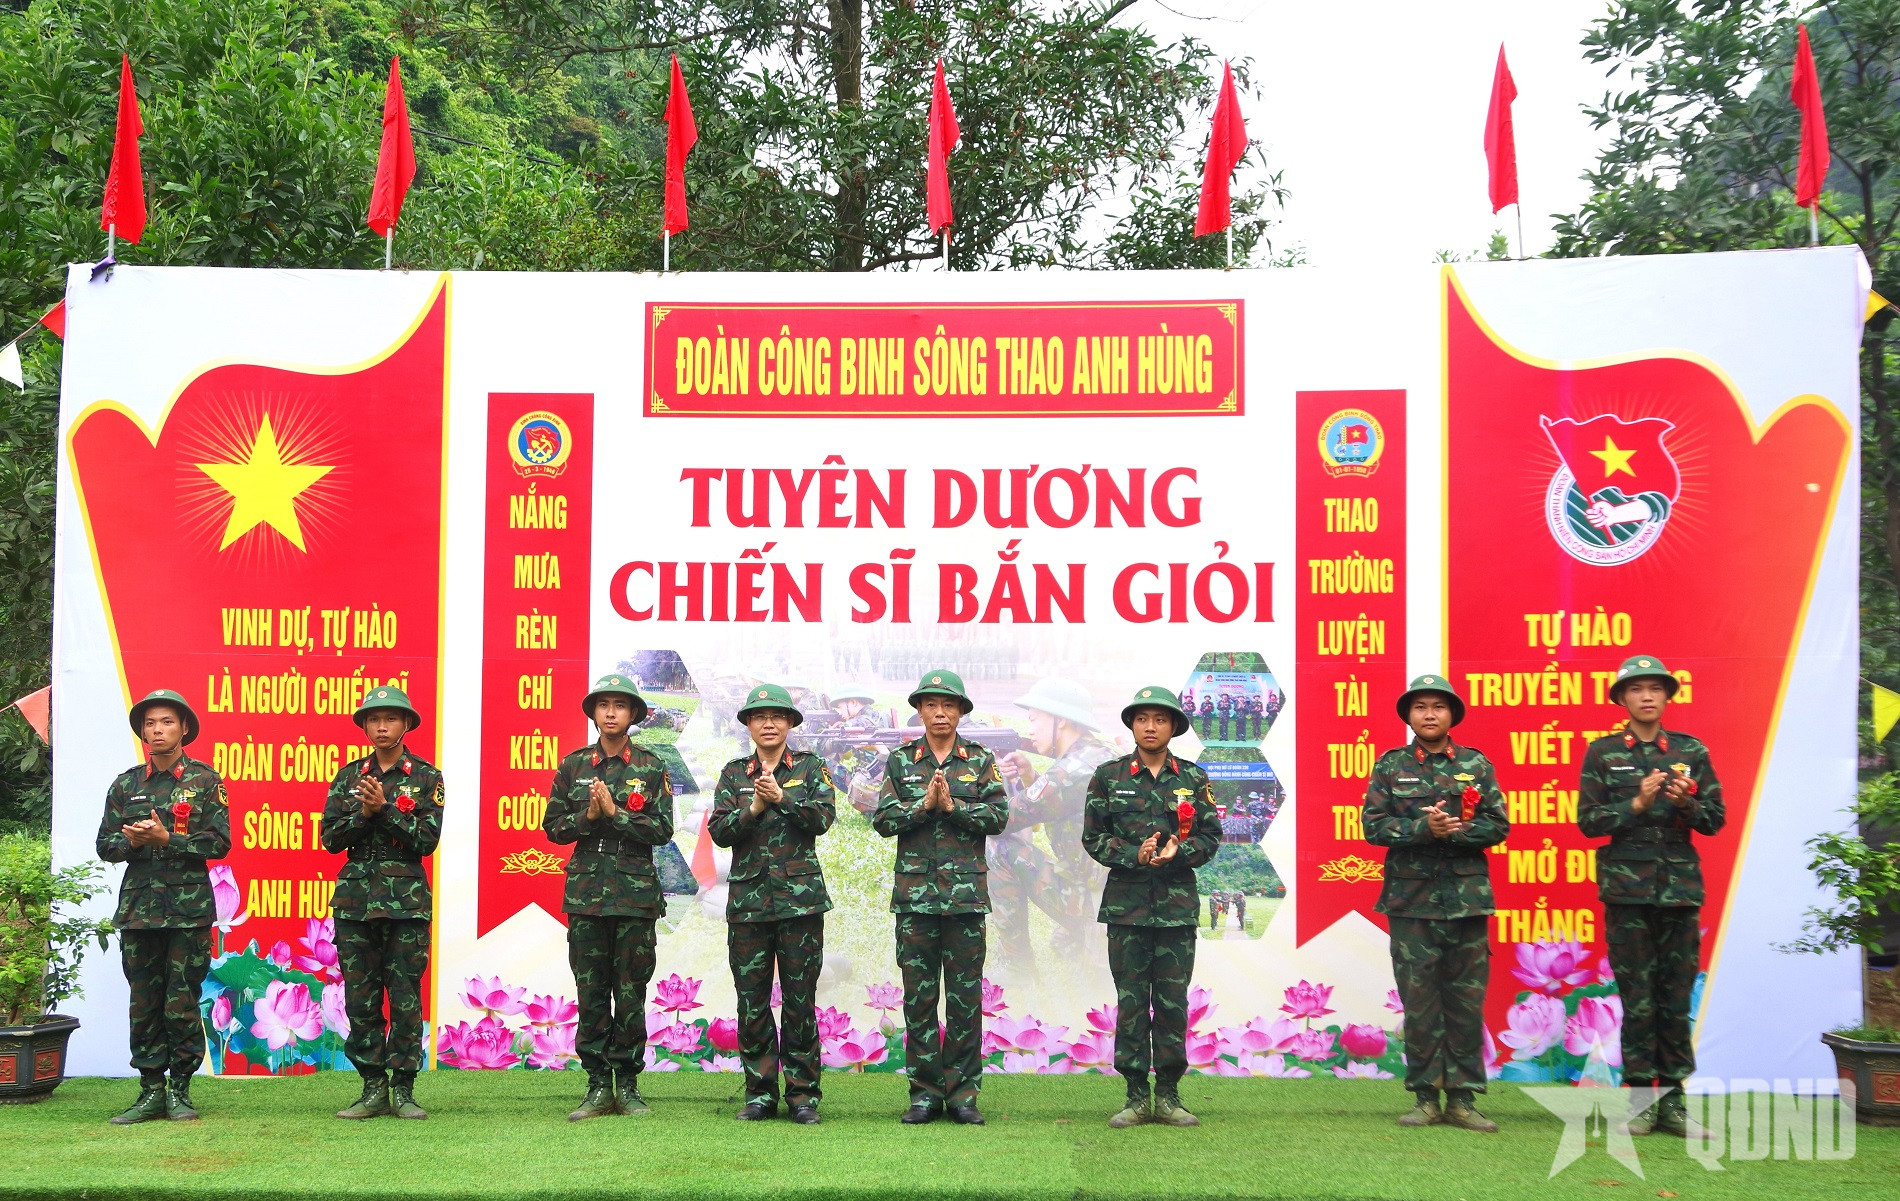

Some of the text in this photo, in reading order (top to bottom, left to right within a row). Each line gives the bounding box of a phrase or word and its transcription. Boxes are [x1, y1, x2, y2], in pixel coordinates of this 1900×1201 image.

[676, 322, 1213, 396] ĐOÀN CÔNG BINH SÔNG THAO ANH HÙNG
[509, 482, 567, 530] NẮNG
[679, 454, 1203, 529] TUYÊN DƯƠNG
[1324, 497, 1379, 534] THAO
[514, 552, 561, 590] MƯA
[609, 539, 1276, 623] CHIẾN SĨ BẮN GIỎI
[1308, 550, 1394, 594] TRƯỜNG
[221, 602, 398, 657] VINH DỰ, TỰ HÀO
[515, 608, 557, 650] RÈN
[1318, 613, 1385, 663] LUYỆN
[1524, 606, 1632, 655] TỰ HÀO
[207, 666, 234, 713] LÀ
[240, 666, 307, 714] NGƯỜI
[518, 668, 552, 710] CHÍ
[1334, 674, 1368, 717] TÀI
[1466, 660, 1582, 707] TRUYỀN
[213, 734, 340, 783] ĐOÀN CÔNG
[509, 729, 559, 771] KIÊN
[1510, 720, 1574, 765] VIẾT
[1501, 779, 1579, 824] HIẾN
[243, 802, 303, 850] SÔNG
[246, 879, 292, 918] ANH
[1494, 896, 1595, 943] THẮNG
